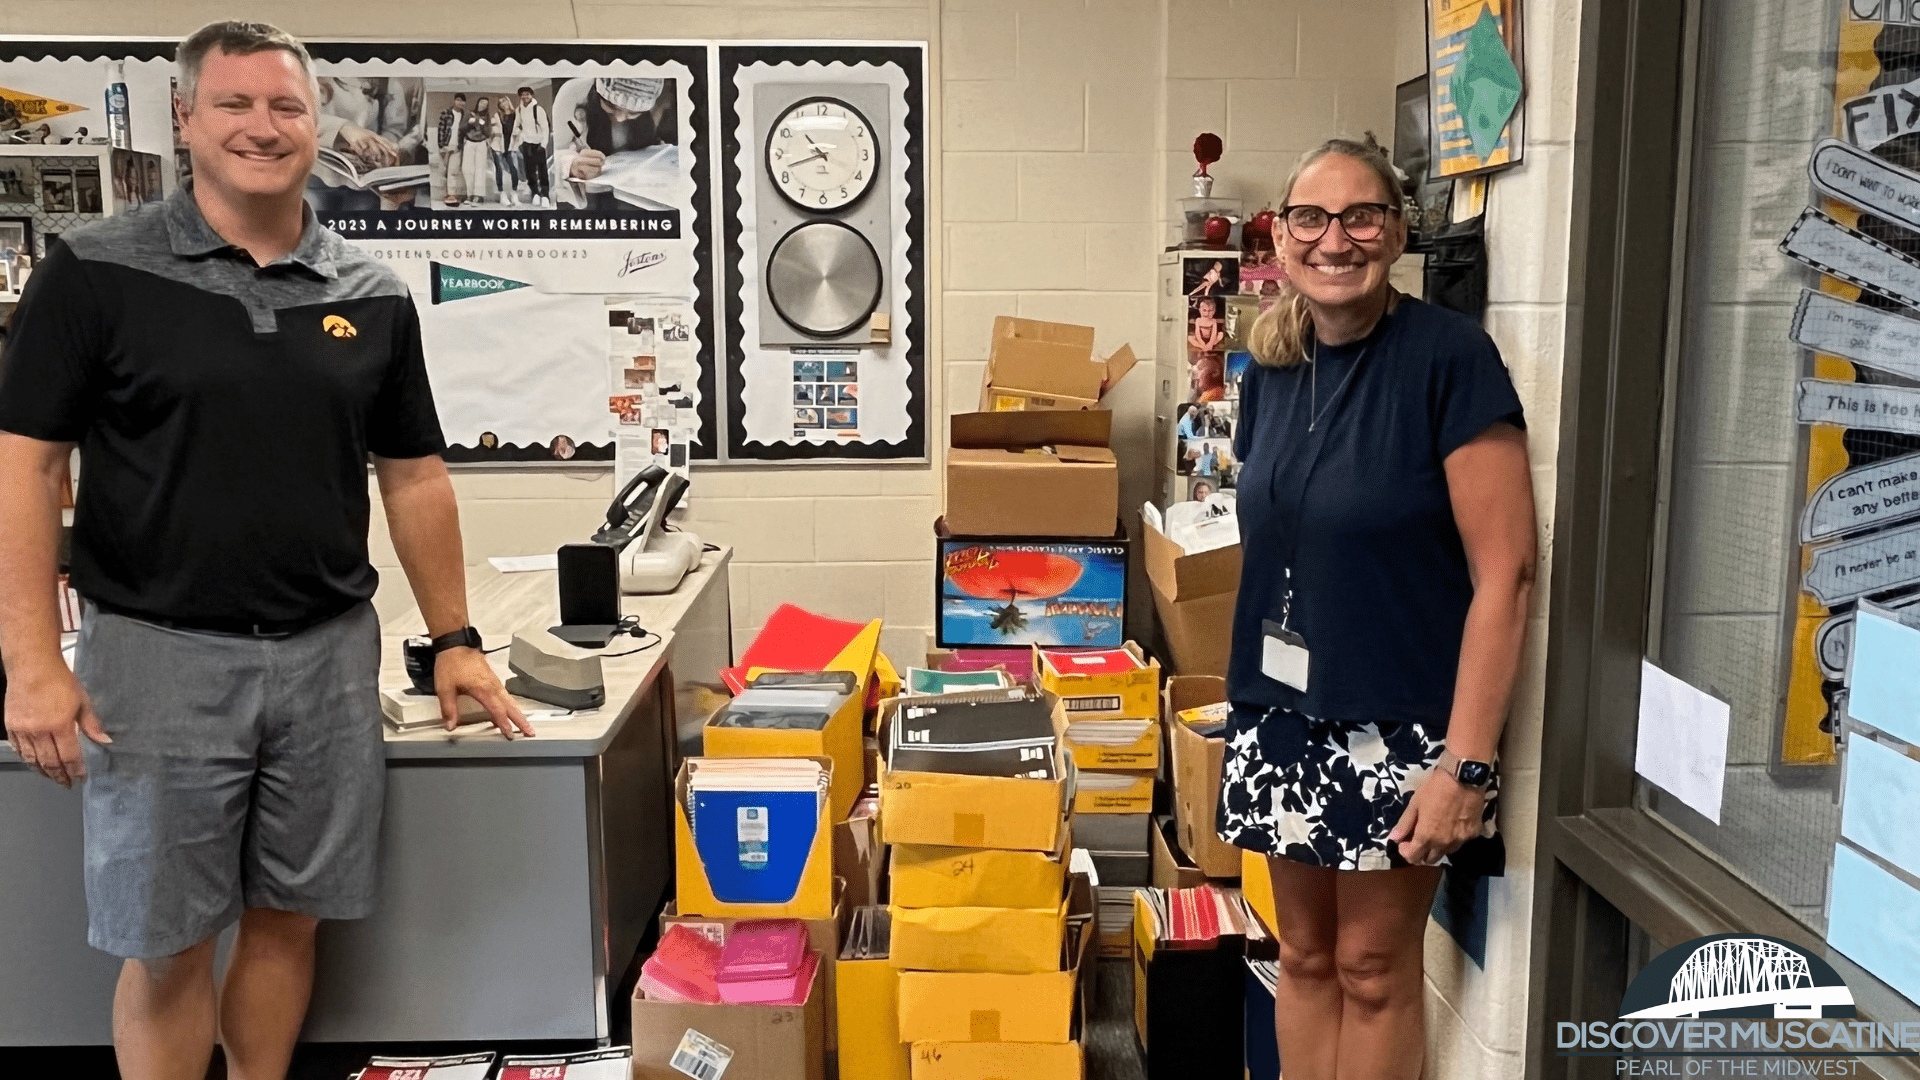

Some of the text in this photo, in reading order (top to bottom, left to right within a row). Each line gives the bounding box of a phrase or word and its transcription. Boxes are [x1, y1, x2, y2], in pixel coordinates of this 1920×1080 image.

[816, 104, 828, 116] 12
[856, 126, 864, 137] 2
[862, 150, 869, 161] 3
[782, 171, 789, 183] 8
[855, 170, 862, 181] 4
[819, 191, 828, 205] 6
[841, 188, 848, 199] 5
[328, 219, 673, 231] 2023 A JOURNEY WORTH REMEMBERING
[374, 250, 588, 259] OSTENS.COM/YEARBOOK23
[441, 277, 506, 289] YEARBOOK
[1827, 395, 1859, 411] This
[1864, 400, 1876, 413] is
[1883, 401, 1908, 416] too
[1838, 480, 1873, 499] can't
[1878, 471, 1918, 489] make
[1852, 502, 1878, 516] any
[1849, 559, 1882, 573] never
[953, 856, 973, 877] 24
[529, 1066, 561, 1079] 125
